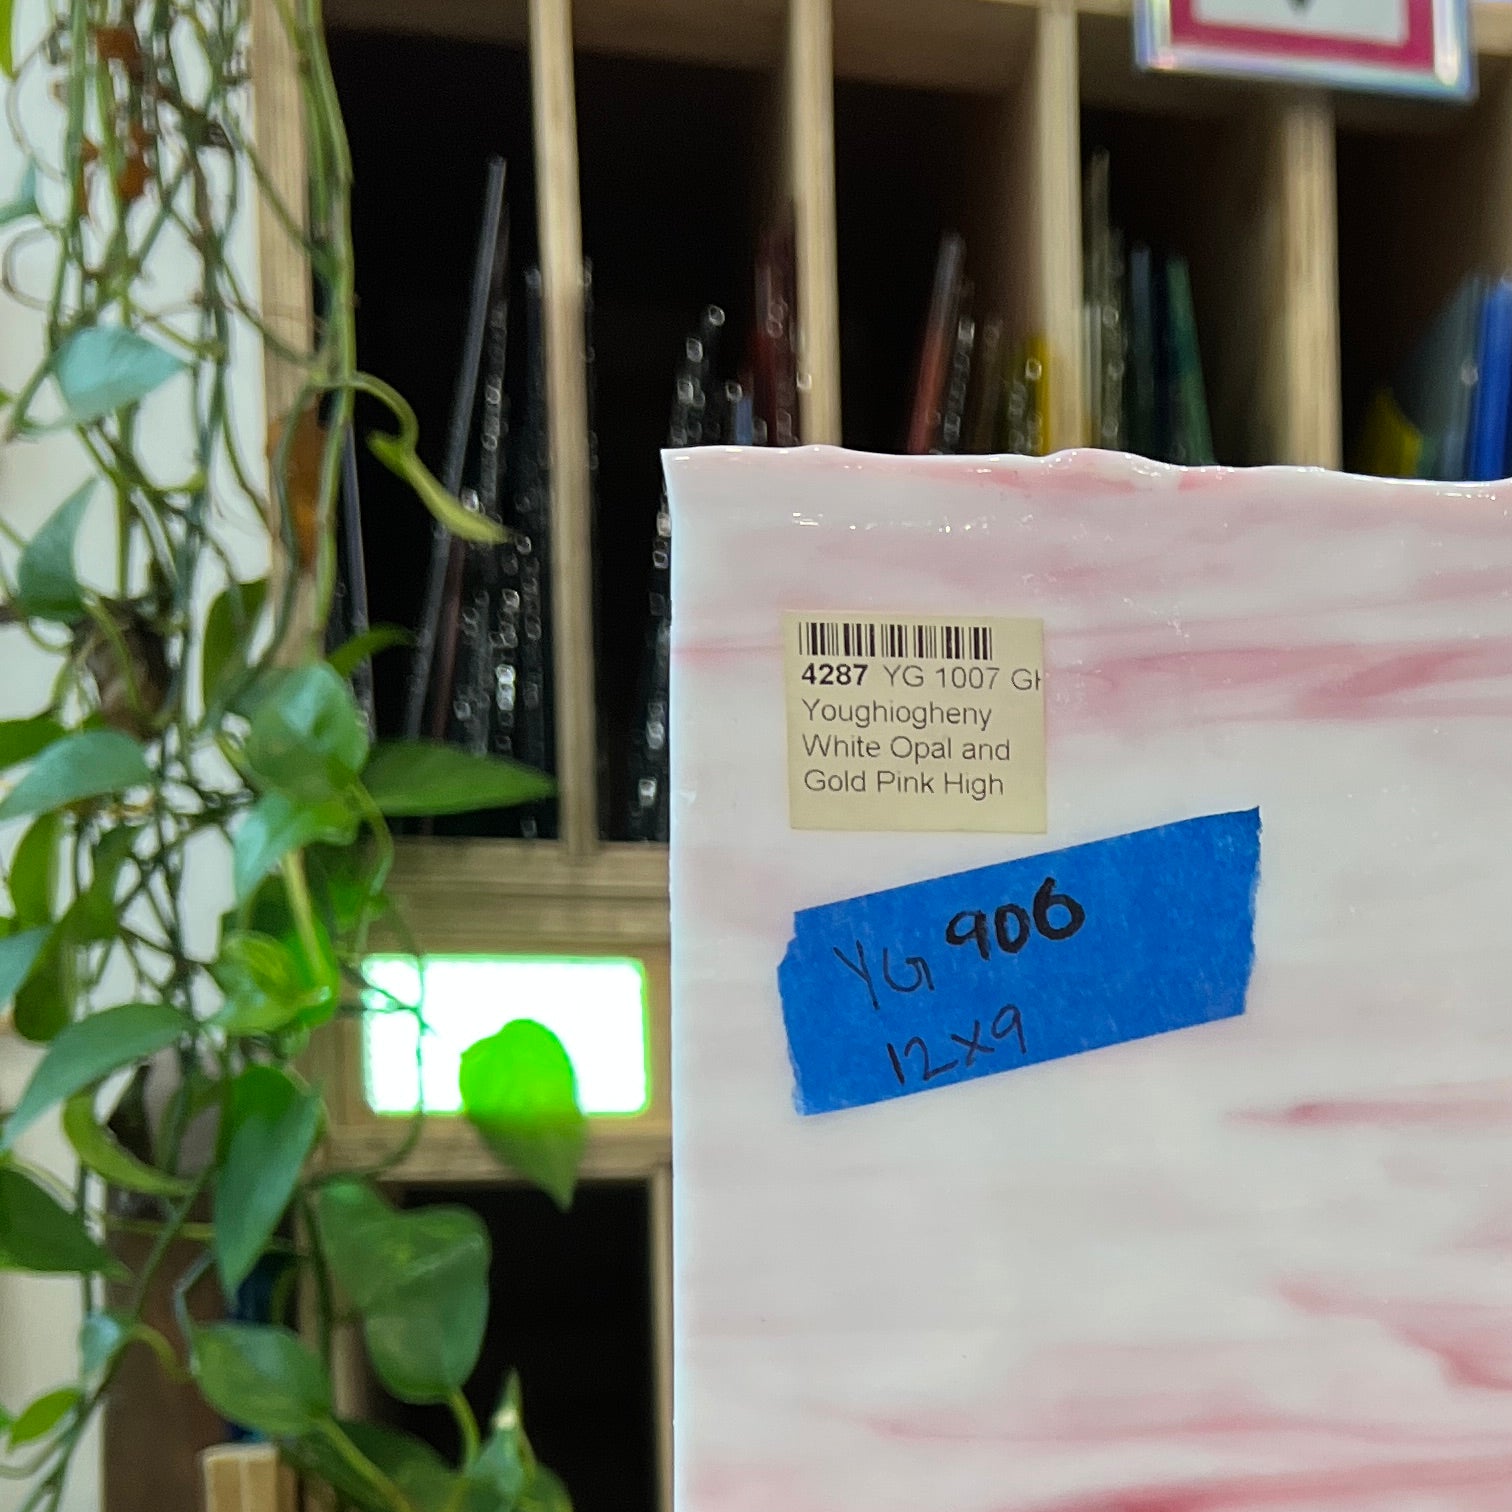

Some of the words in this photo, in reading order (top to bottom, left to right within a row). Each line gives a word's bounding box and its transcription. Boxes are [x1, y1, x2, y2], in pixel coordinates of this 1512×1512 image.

[802, 663, 868, 685] 4287
[883, 665, 925, 687] YG
[935, 667, 1000, 690] 1007
[801, 698, 992, 731] Youghiogheny
[802, 734, 880, 757] White
[890, 736, 951, 764] Opal
[962, 739, 1010, 761] and
[804, 769, 867, 792] Gold
[877, 770, 934, 794] Pink
[944, 772, 1004, 801] High
[834, 939, 935, 1011] YG
[945, 876, 1086, 961] 906
